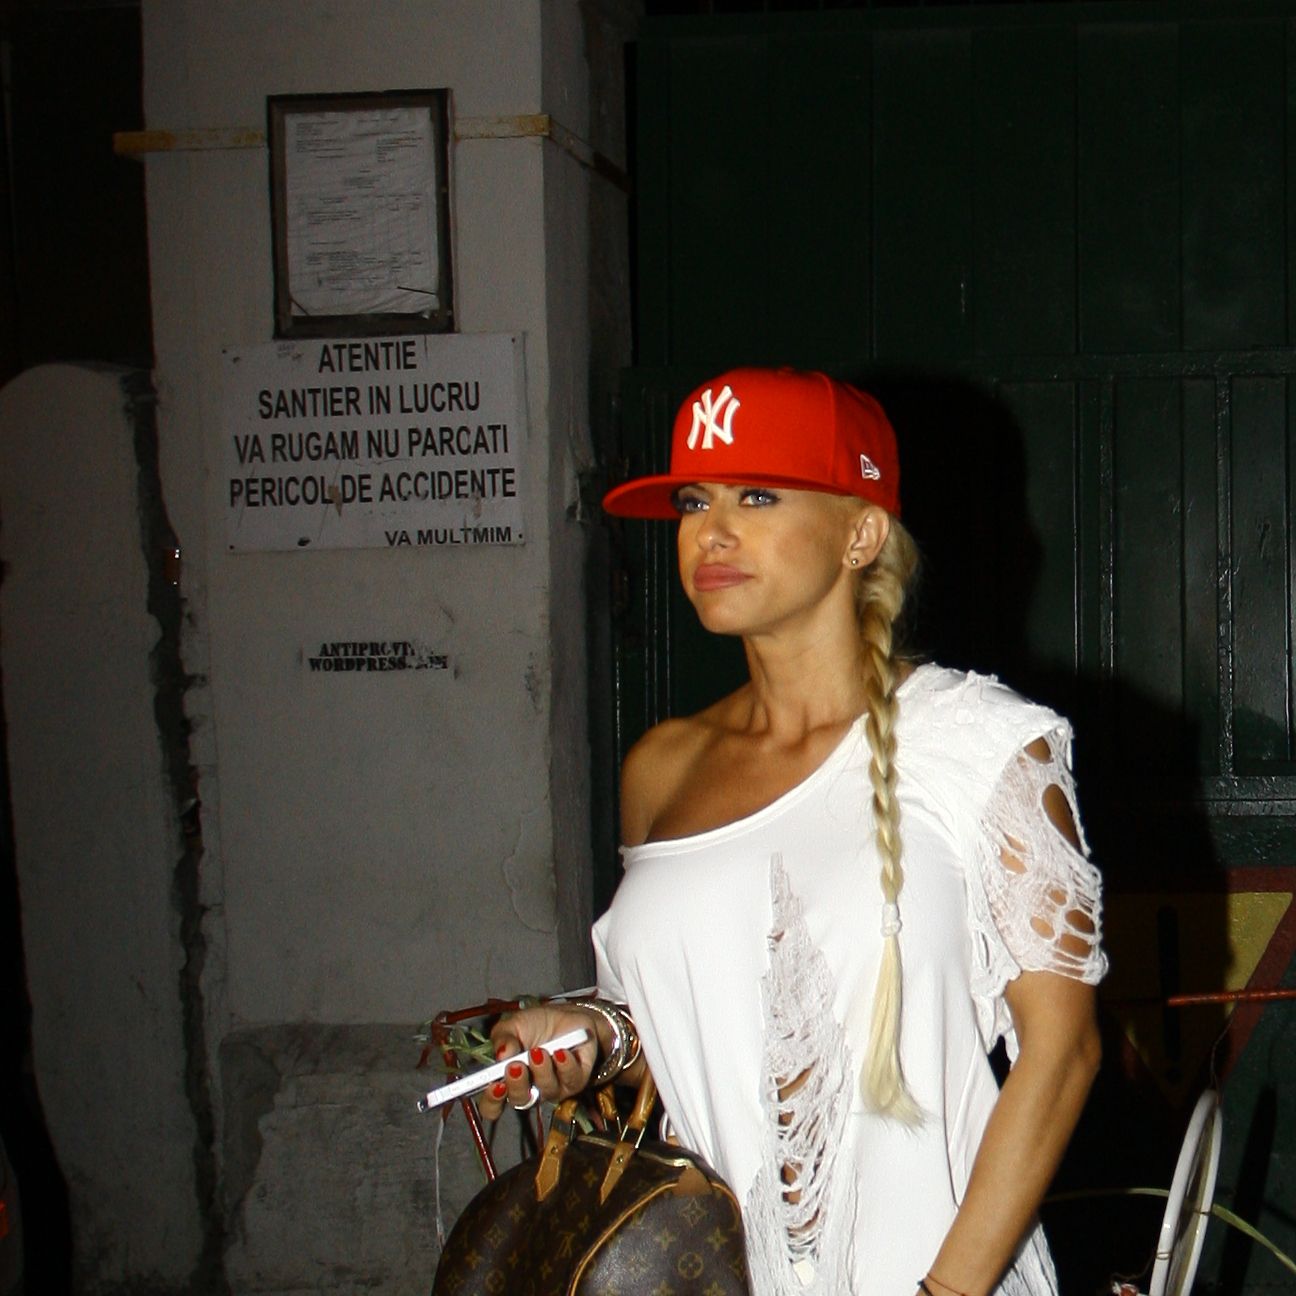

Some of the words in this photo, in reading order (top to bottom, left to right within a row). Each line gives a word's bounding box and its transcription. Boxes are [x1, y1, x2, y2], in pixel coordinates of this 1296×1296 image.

[318, 340, 418, 373] ATENTIE
[258, 386, 362, 420] SANTIER
[368, 385, 392, 415] IN
[399, 381, 481, 414] LUCRU
[686, 384, 741, 450] NY
[234, 434, 266, 464] VA
[271, 430, 360, 462] RUGAM
[367, 428, 400, 459] NU
[407, 424, 510, 457] PARCATI
[230, 475, 333, 507] PERICOL
[341, 473, 373, 504] DE
[379, 467, 517, 502] ACCIDENTE
[385, 530, 412, 546] VA
